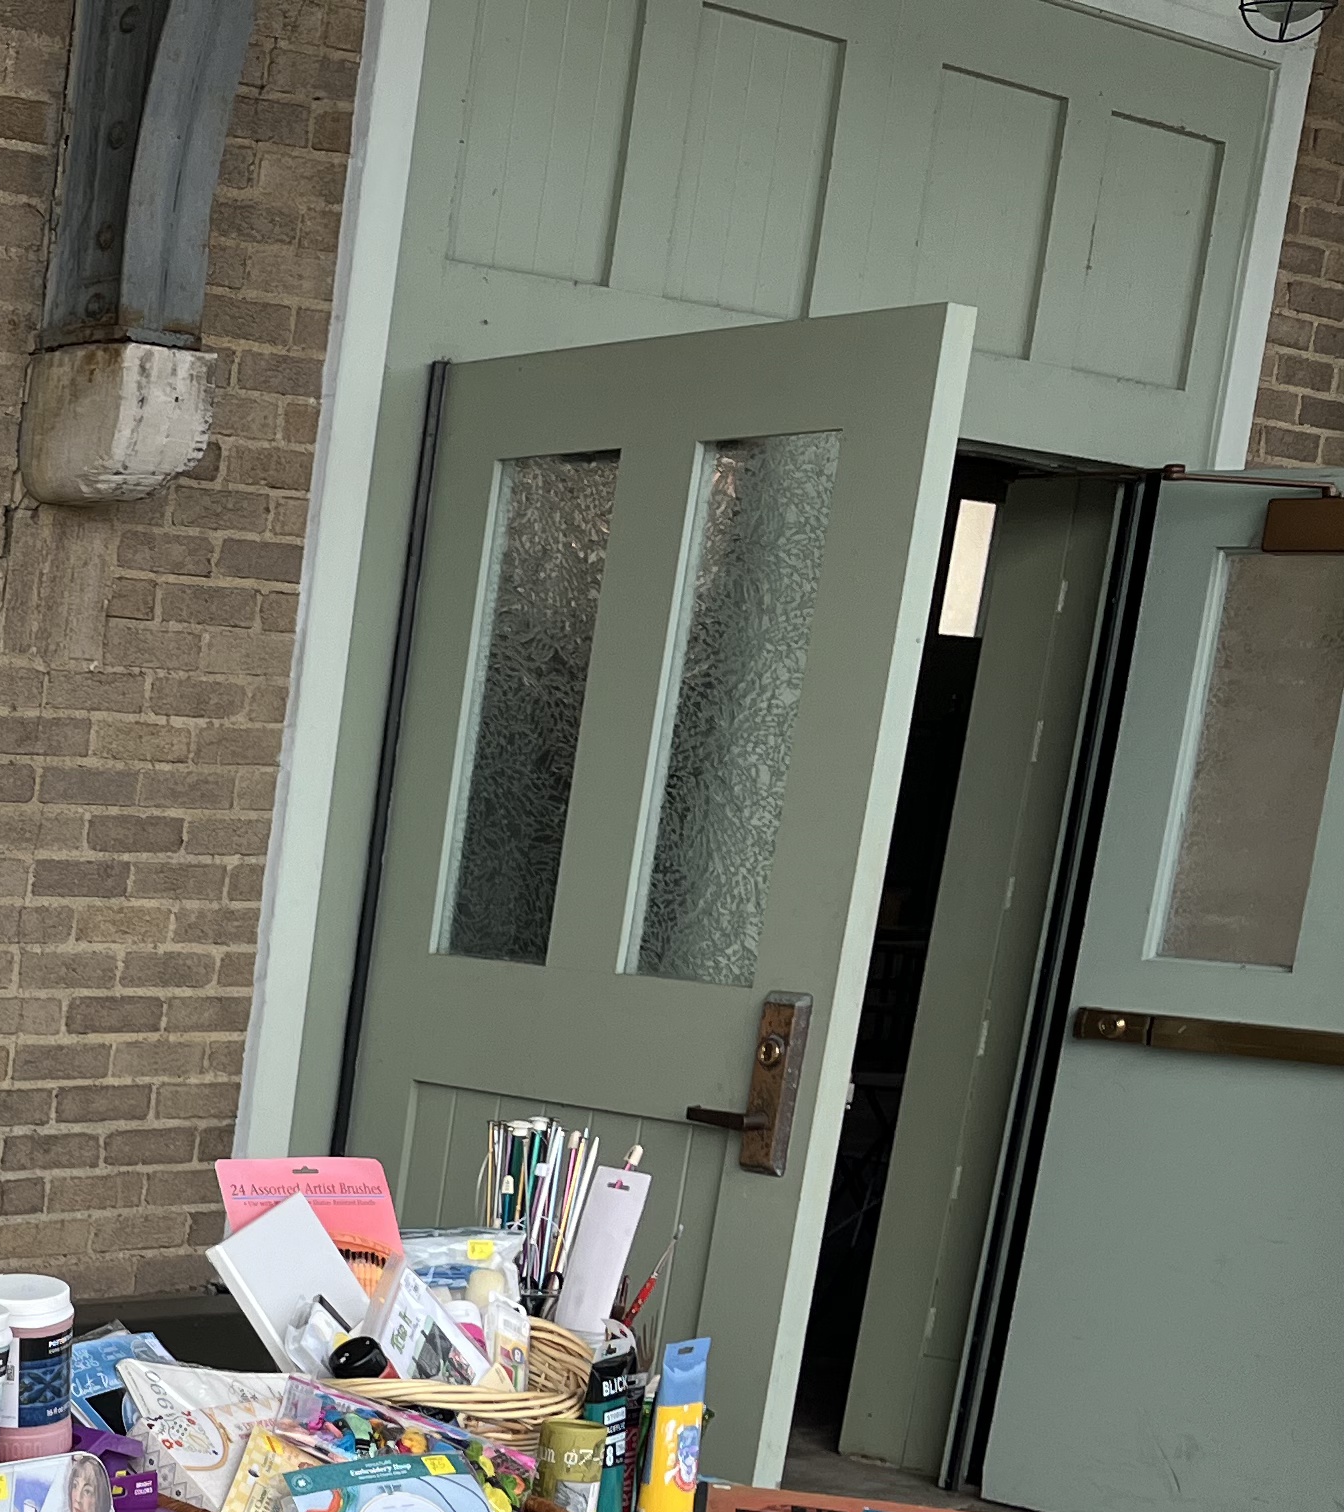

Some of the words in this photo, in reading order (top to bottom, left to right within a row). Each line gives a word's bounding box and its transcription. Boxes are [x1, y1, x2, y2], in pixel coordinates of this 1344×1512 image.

[230, 1183, 246, 1197] 24
[250, 1183, 301, 1197] Assorted
[305, 1183, 337, 1196] Artist
[340, 1182, 383, 1196] Brushes
[602, 1376, 629, 1397] BLICK
